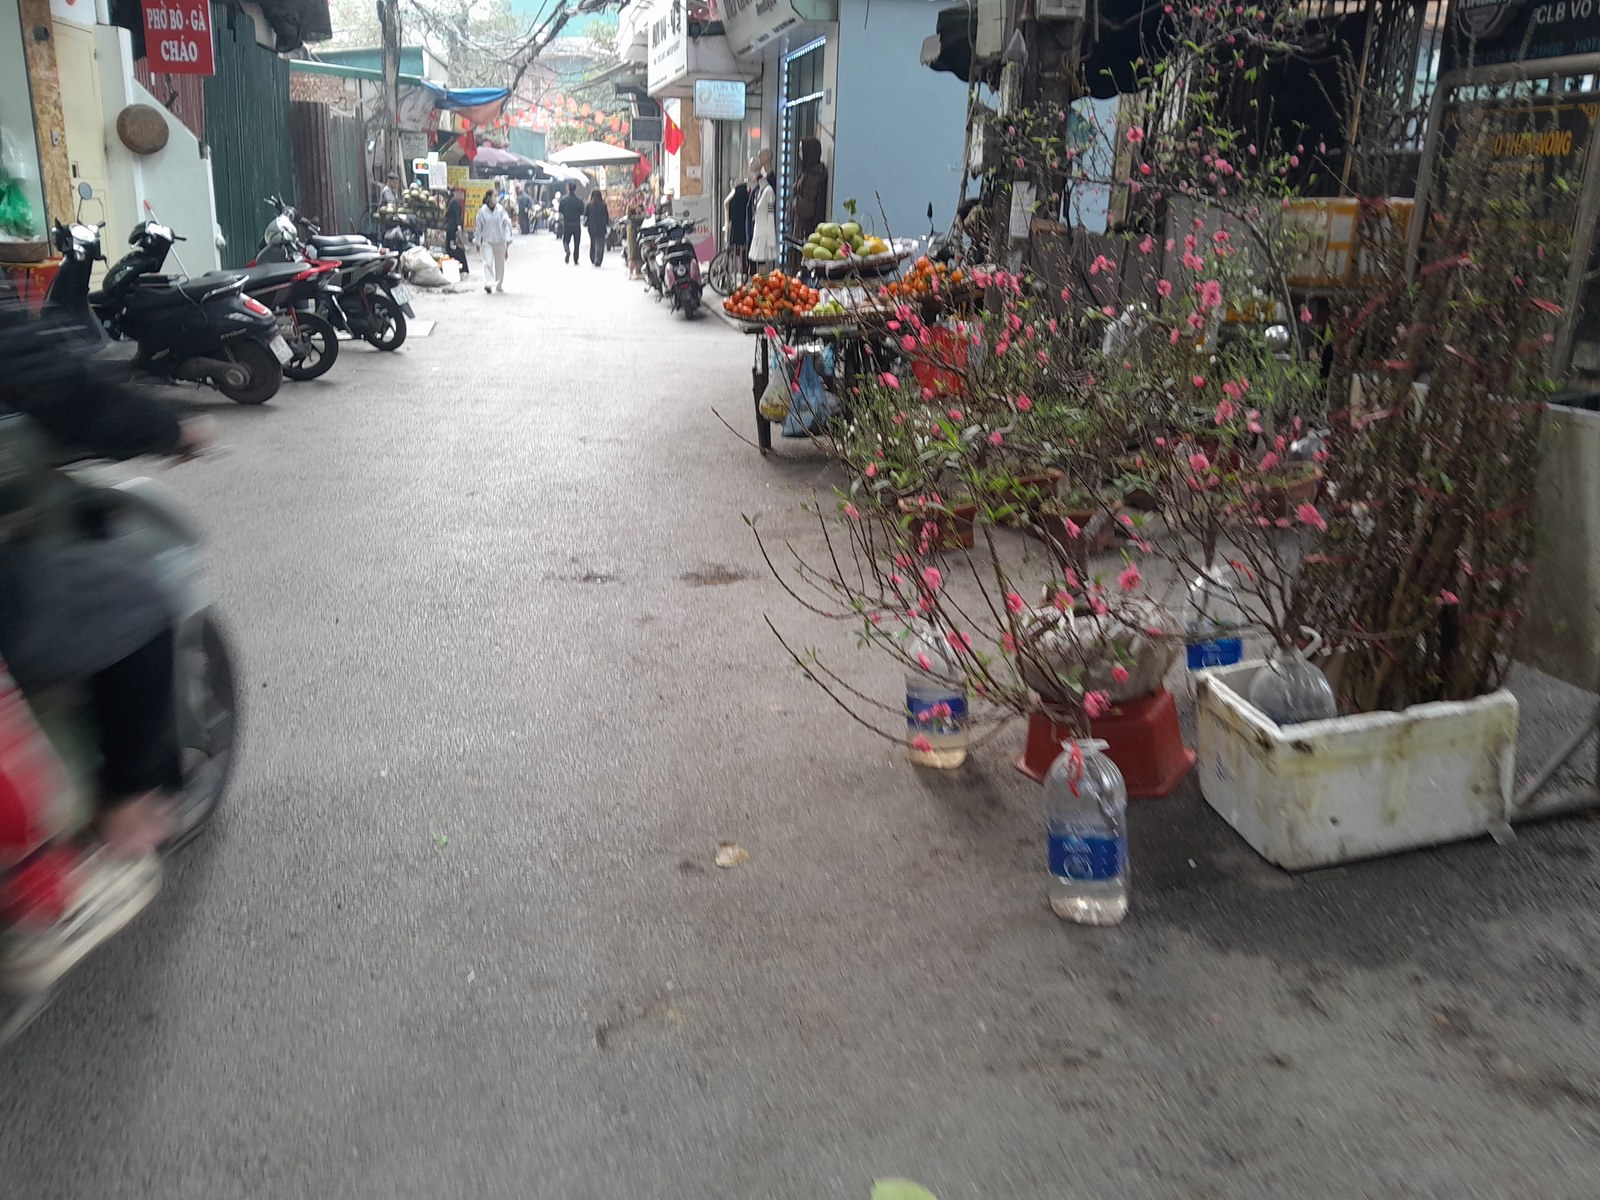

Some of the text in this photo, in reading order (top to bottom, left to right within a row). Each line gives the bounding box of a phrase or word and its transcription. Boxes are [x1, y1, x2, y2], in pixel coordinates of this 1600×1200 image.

[146, 0, 167, 29] PHỞ
[169, 3, 184, 30] BÒ
[190, 3, 207, 31] GÀ
[1536, 2, 1566, 24] CLB
[161, 34, 198, 62] CHÁO
